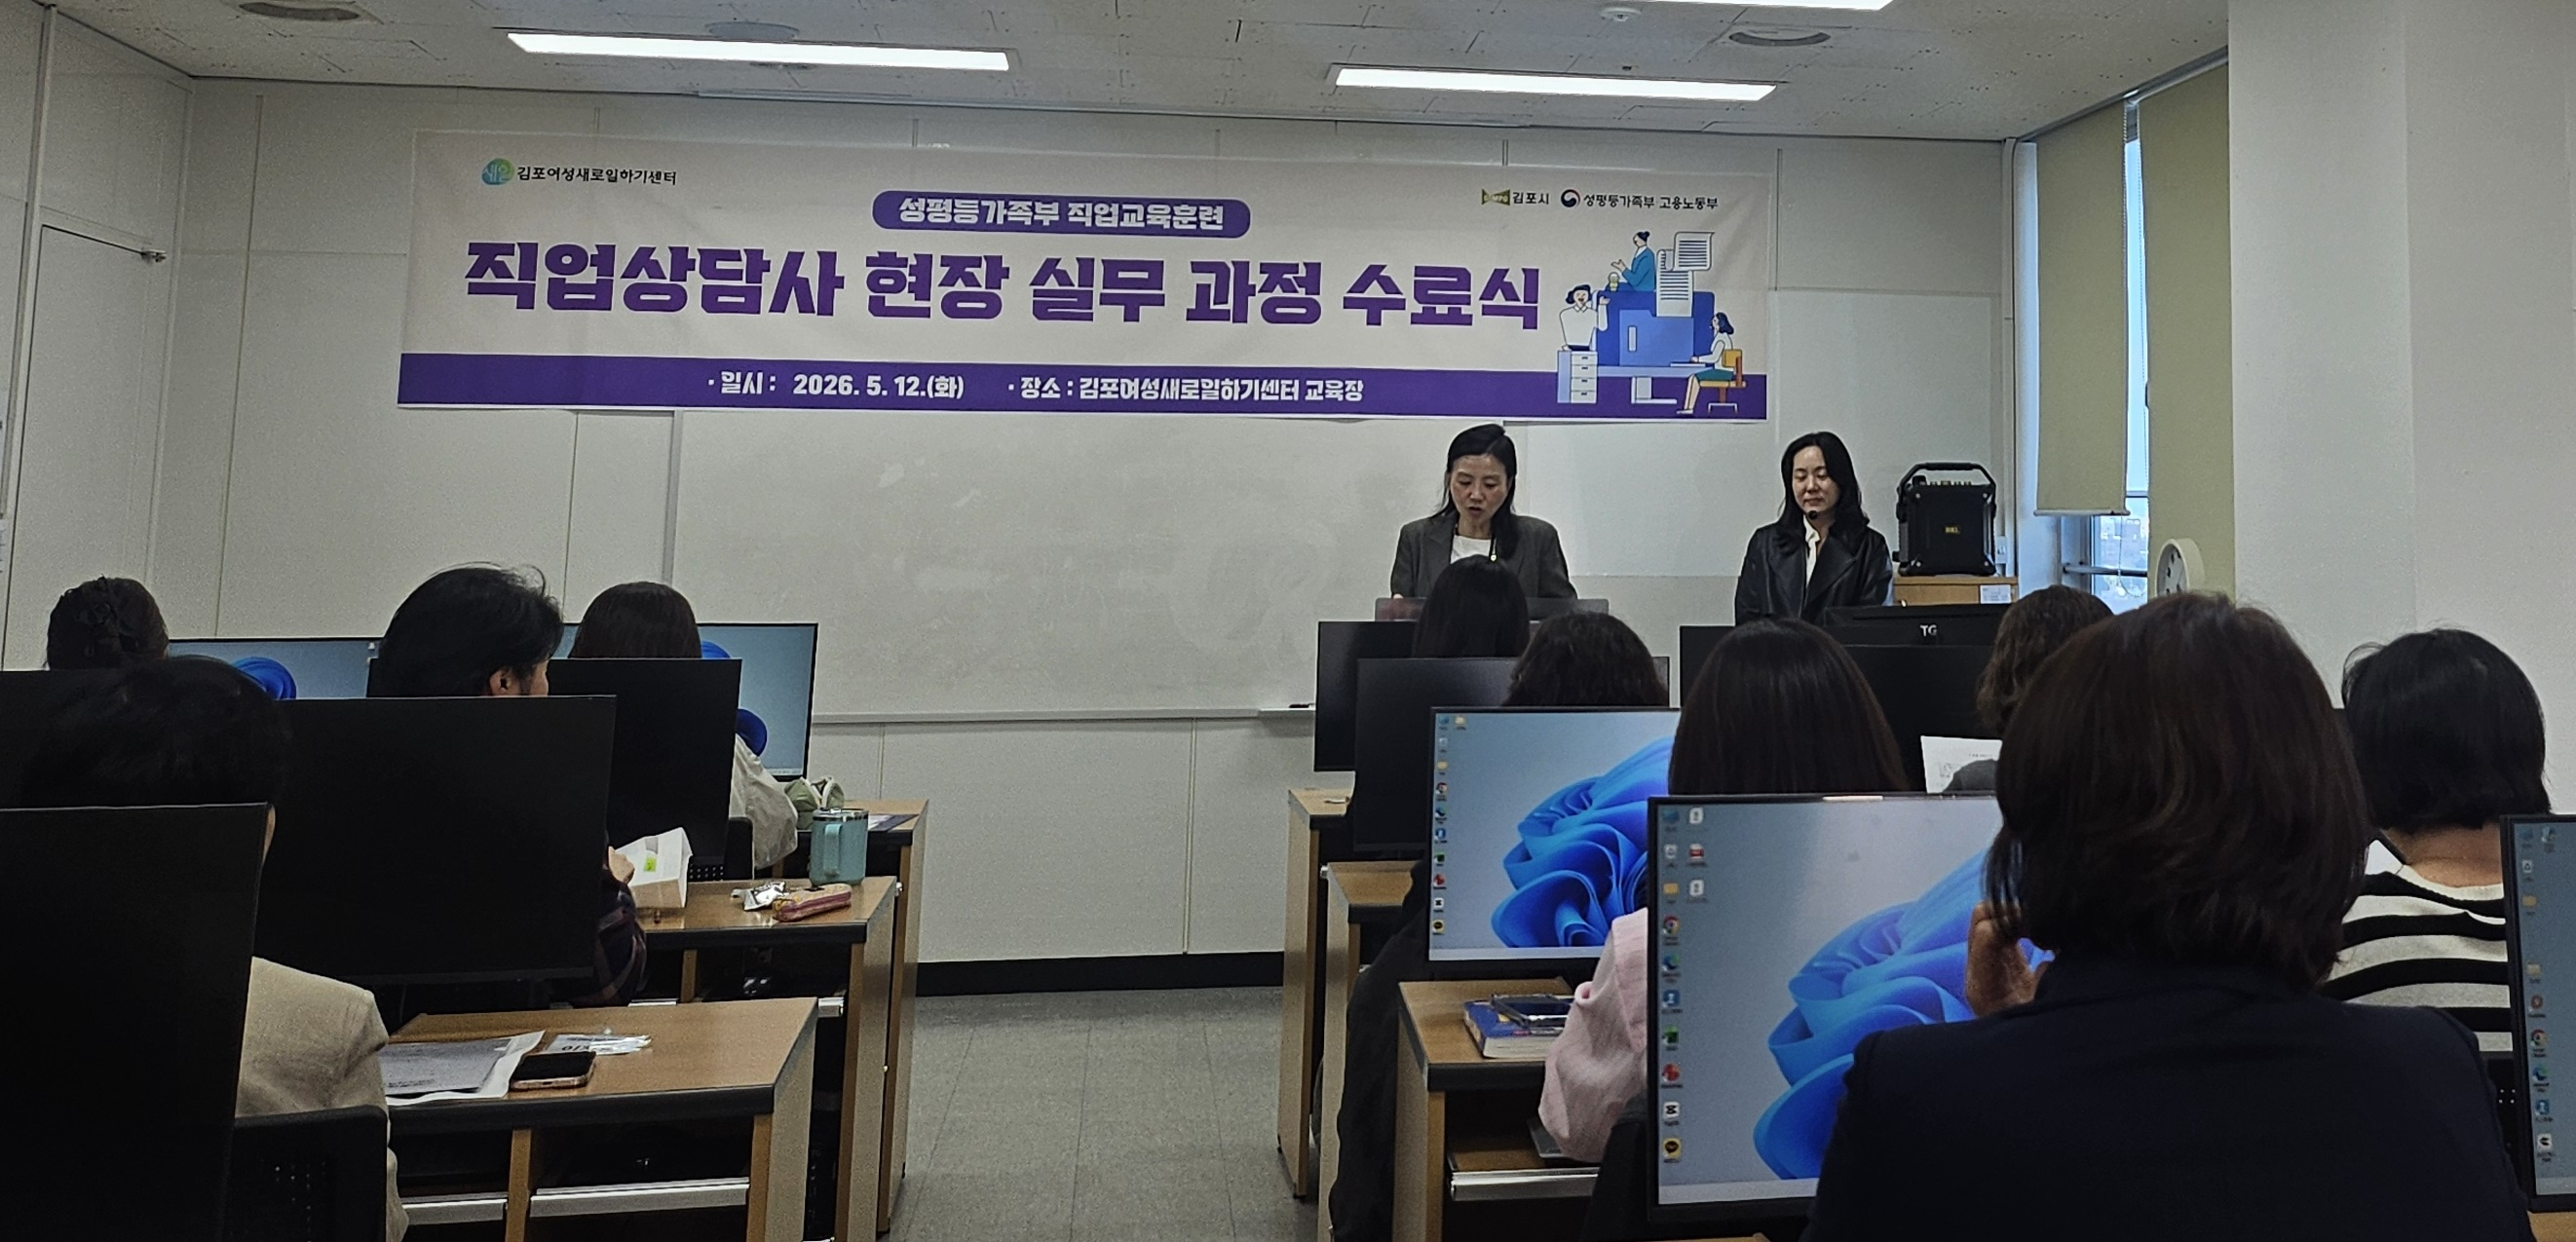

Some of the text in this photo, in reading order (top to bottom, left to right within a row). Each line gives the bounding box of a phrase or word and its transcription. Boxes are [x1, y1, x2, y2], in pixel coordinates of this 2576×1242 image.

[516, 166, 677, 186] 김포여성새로일하기센터
[1512, 191, 1549, 206] 김포시
[1583, 194, 1719, 210] 성평등가족부 고용노동부
[899, 198, 1224, 230] 성평등가족부 직업교육훈련
[465, 242, 1539, 330] 직업상담사 현장 실무 과정 수료식
[792, 373, 860, 395] 2026.
[866, 375, 889, 396] 5.
[893, 375, 965, 399] 12.(화)
[1080, 377, 1300, 401] 김포여성새로일하기센터
[1305, 379, 1364, 402] 교육장
[1919, 624, 1938, 637] TG
